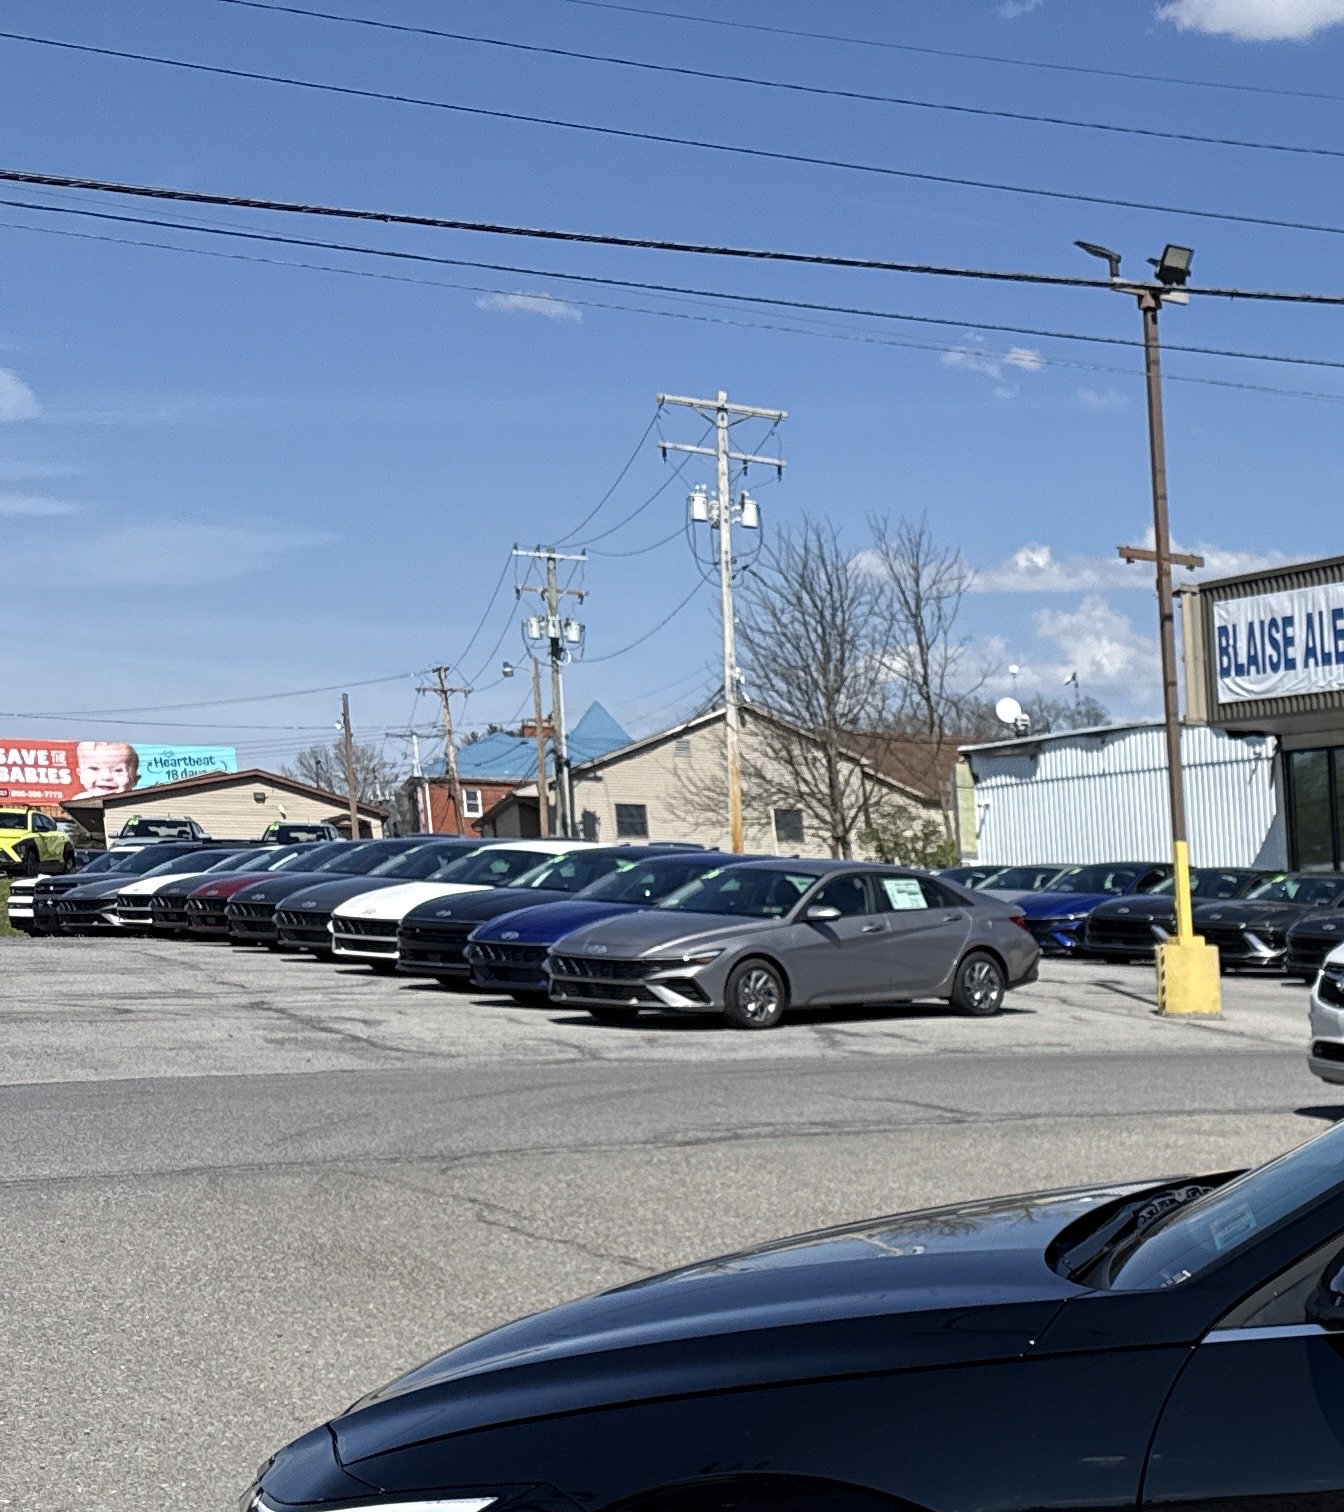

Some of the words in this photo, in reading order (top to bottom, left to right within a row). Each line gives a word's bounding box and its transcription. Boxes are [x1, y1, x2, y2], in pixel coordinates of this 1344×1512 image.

[1217, 614, 1296, 680] BLAISE
[153, 755, 216, 768] Heartbeat
[165, 769, 179, 780] 18
